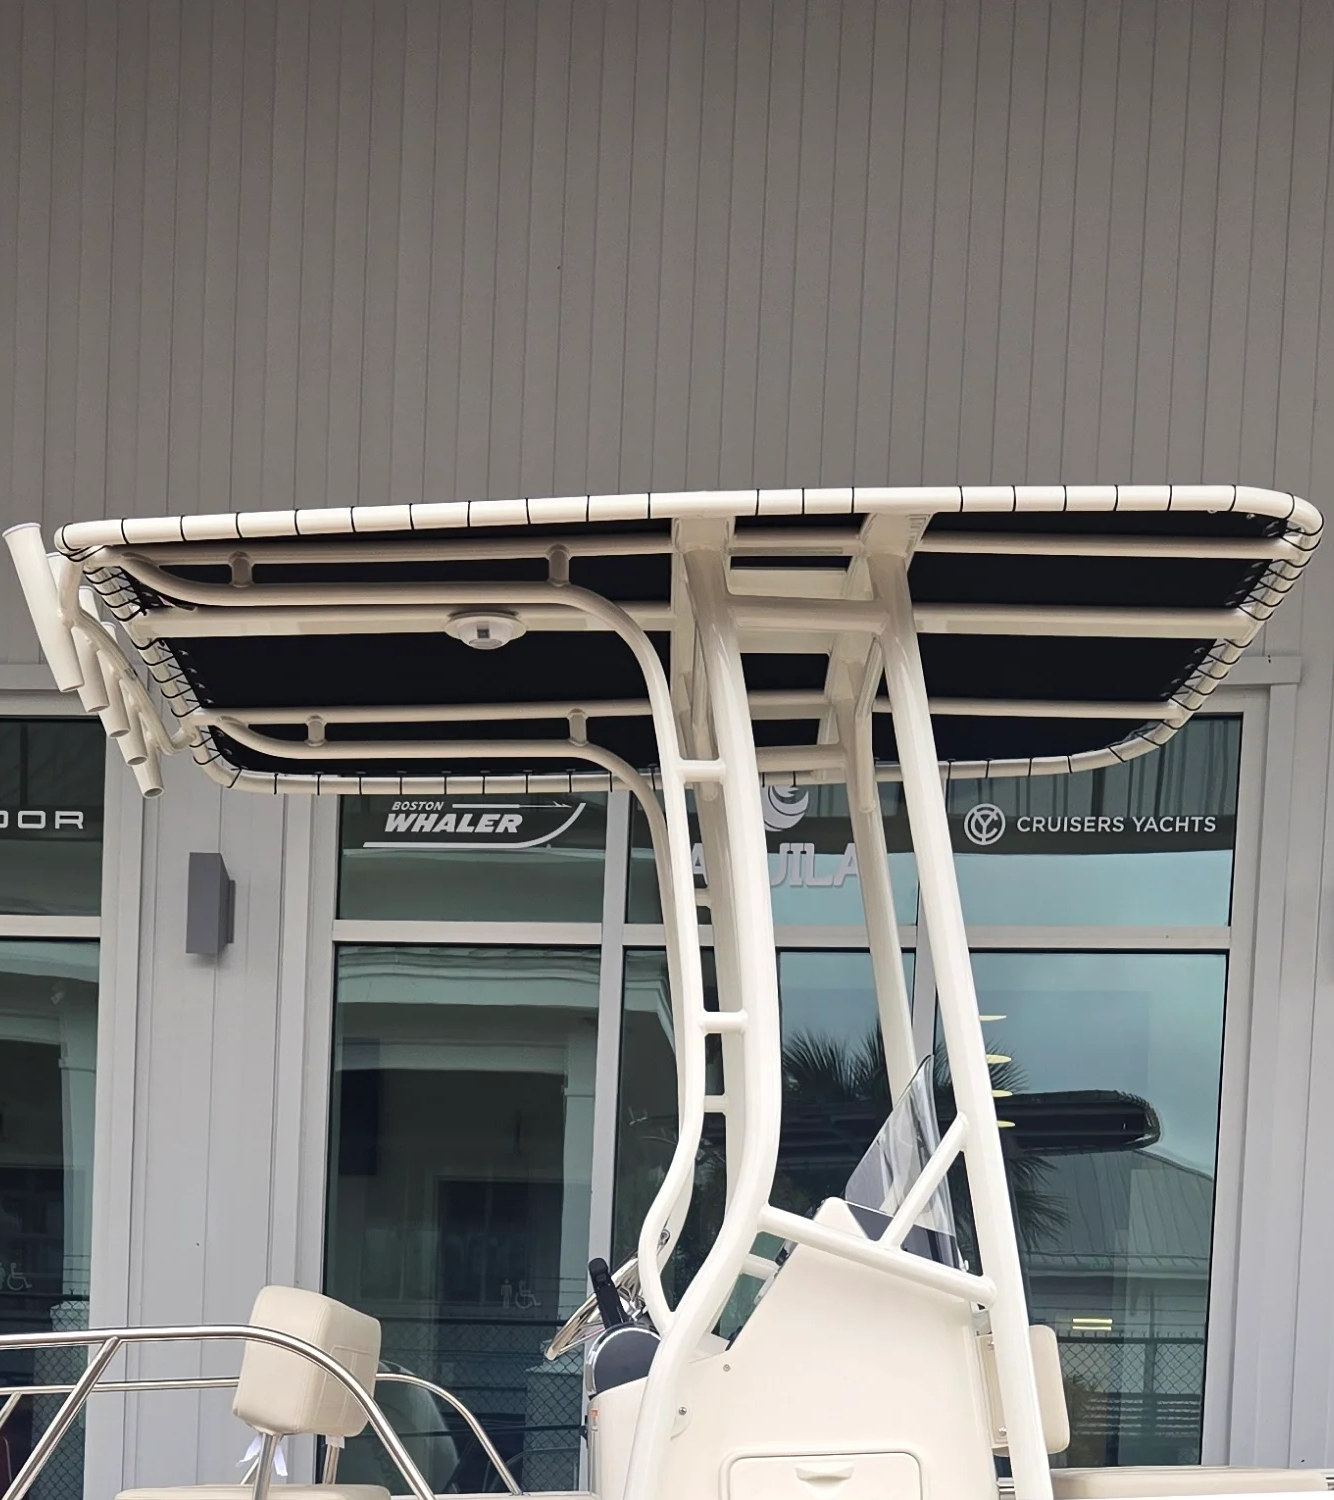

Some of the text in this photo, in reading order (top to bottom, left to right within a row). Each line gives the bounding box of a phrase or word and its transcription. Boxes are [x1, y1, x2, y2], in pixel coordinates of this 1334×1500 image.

[391, 801, 444, 812] BOSTON
[384, 813, 523, 834] WHALER
[1016, 816, 1217, 833] CRUISERS YACHTS
